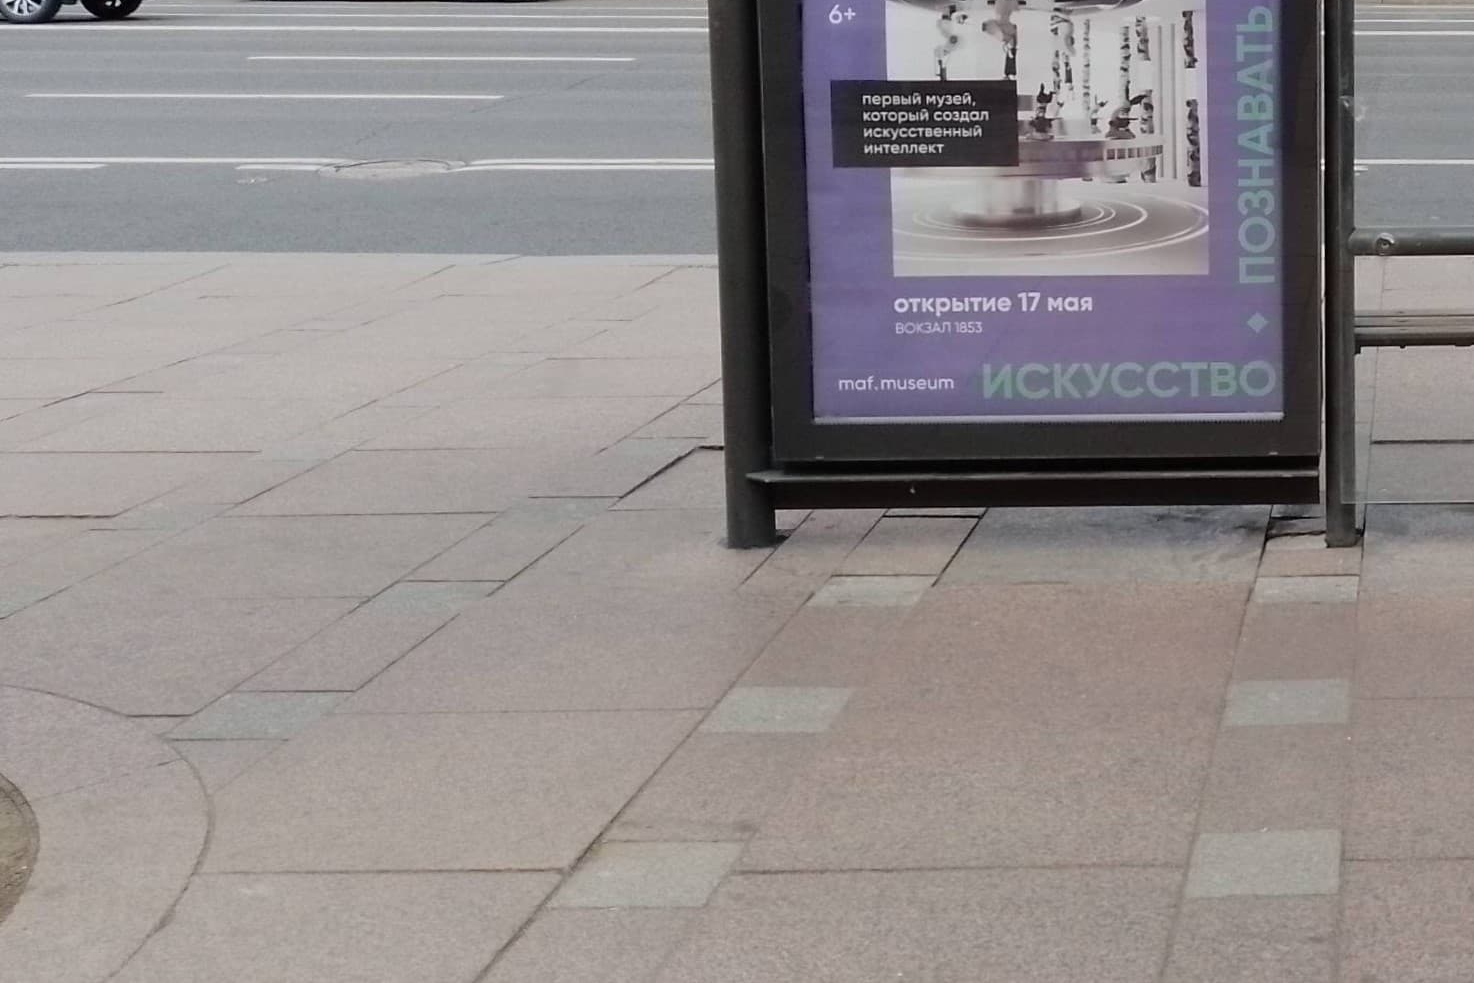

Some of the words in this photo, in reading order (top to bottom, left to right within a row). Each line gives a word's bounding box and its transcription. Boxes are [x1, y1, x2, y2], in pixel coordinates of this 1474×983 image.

[828, 4, 856, 24] 6+
[862, 92, 921, 107] первый
[926, 93, 976, 107] музей,
[863, 109, 929, 124] который
[933, 110, 989, 123] создал
[863, 125, 982, 140] искусственный
[864, 142, 944, 155] интеллект
[1236, 5, 1276, 284] ПОЗНАВАТЬ
[893, 294, 1012, 317] открытие
[1017, 292, 1041, 312] 17
[1047, 295, 1093, 312] мая
[895, 322, 951, 335] ВОКЗАЛ
[953, 321, 983, 335] 1853
[838, 374, 955, 392] maf.museum
[981, 360, 1277, 401] ИСКУССТВО
